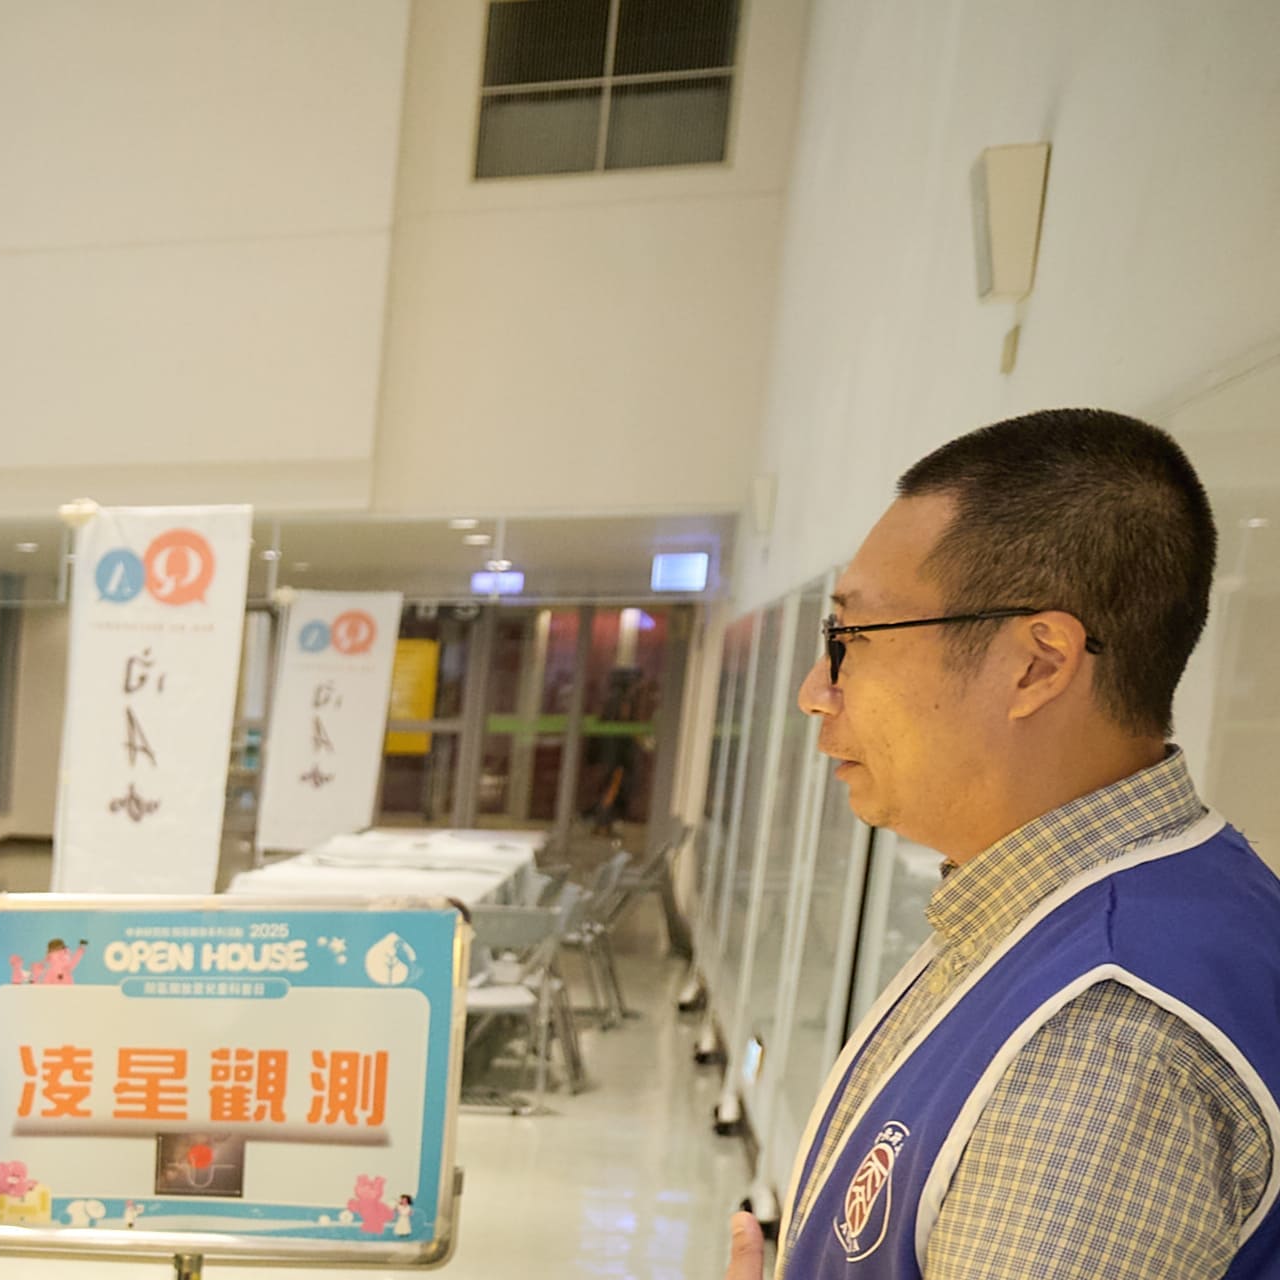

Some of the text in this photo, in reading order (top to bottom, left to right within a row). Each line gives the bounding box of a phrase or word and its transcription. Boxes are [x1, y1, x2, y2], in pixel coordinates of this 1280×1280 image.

[250, 923, 289, 939] 2025
[103, 940, 309, 973] OPEN HOUSE
[17, 1045, 388, 1127] 凌星觀測
